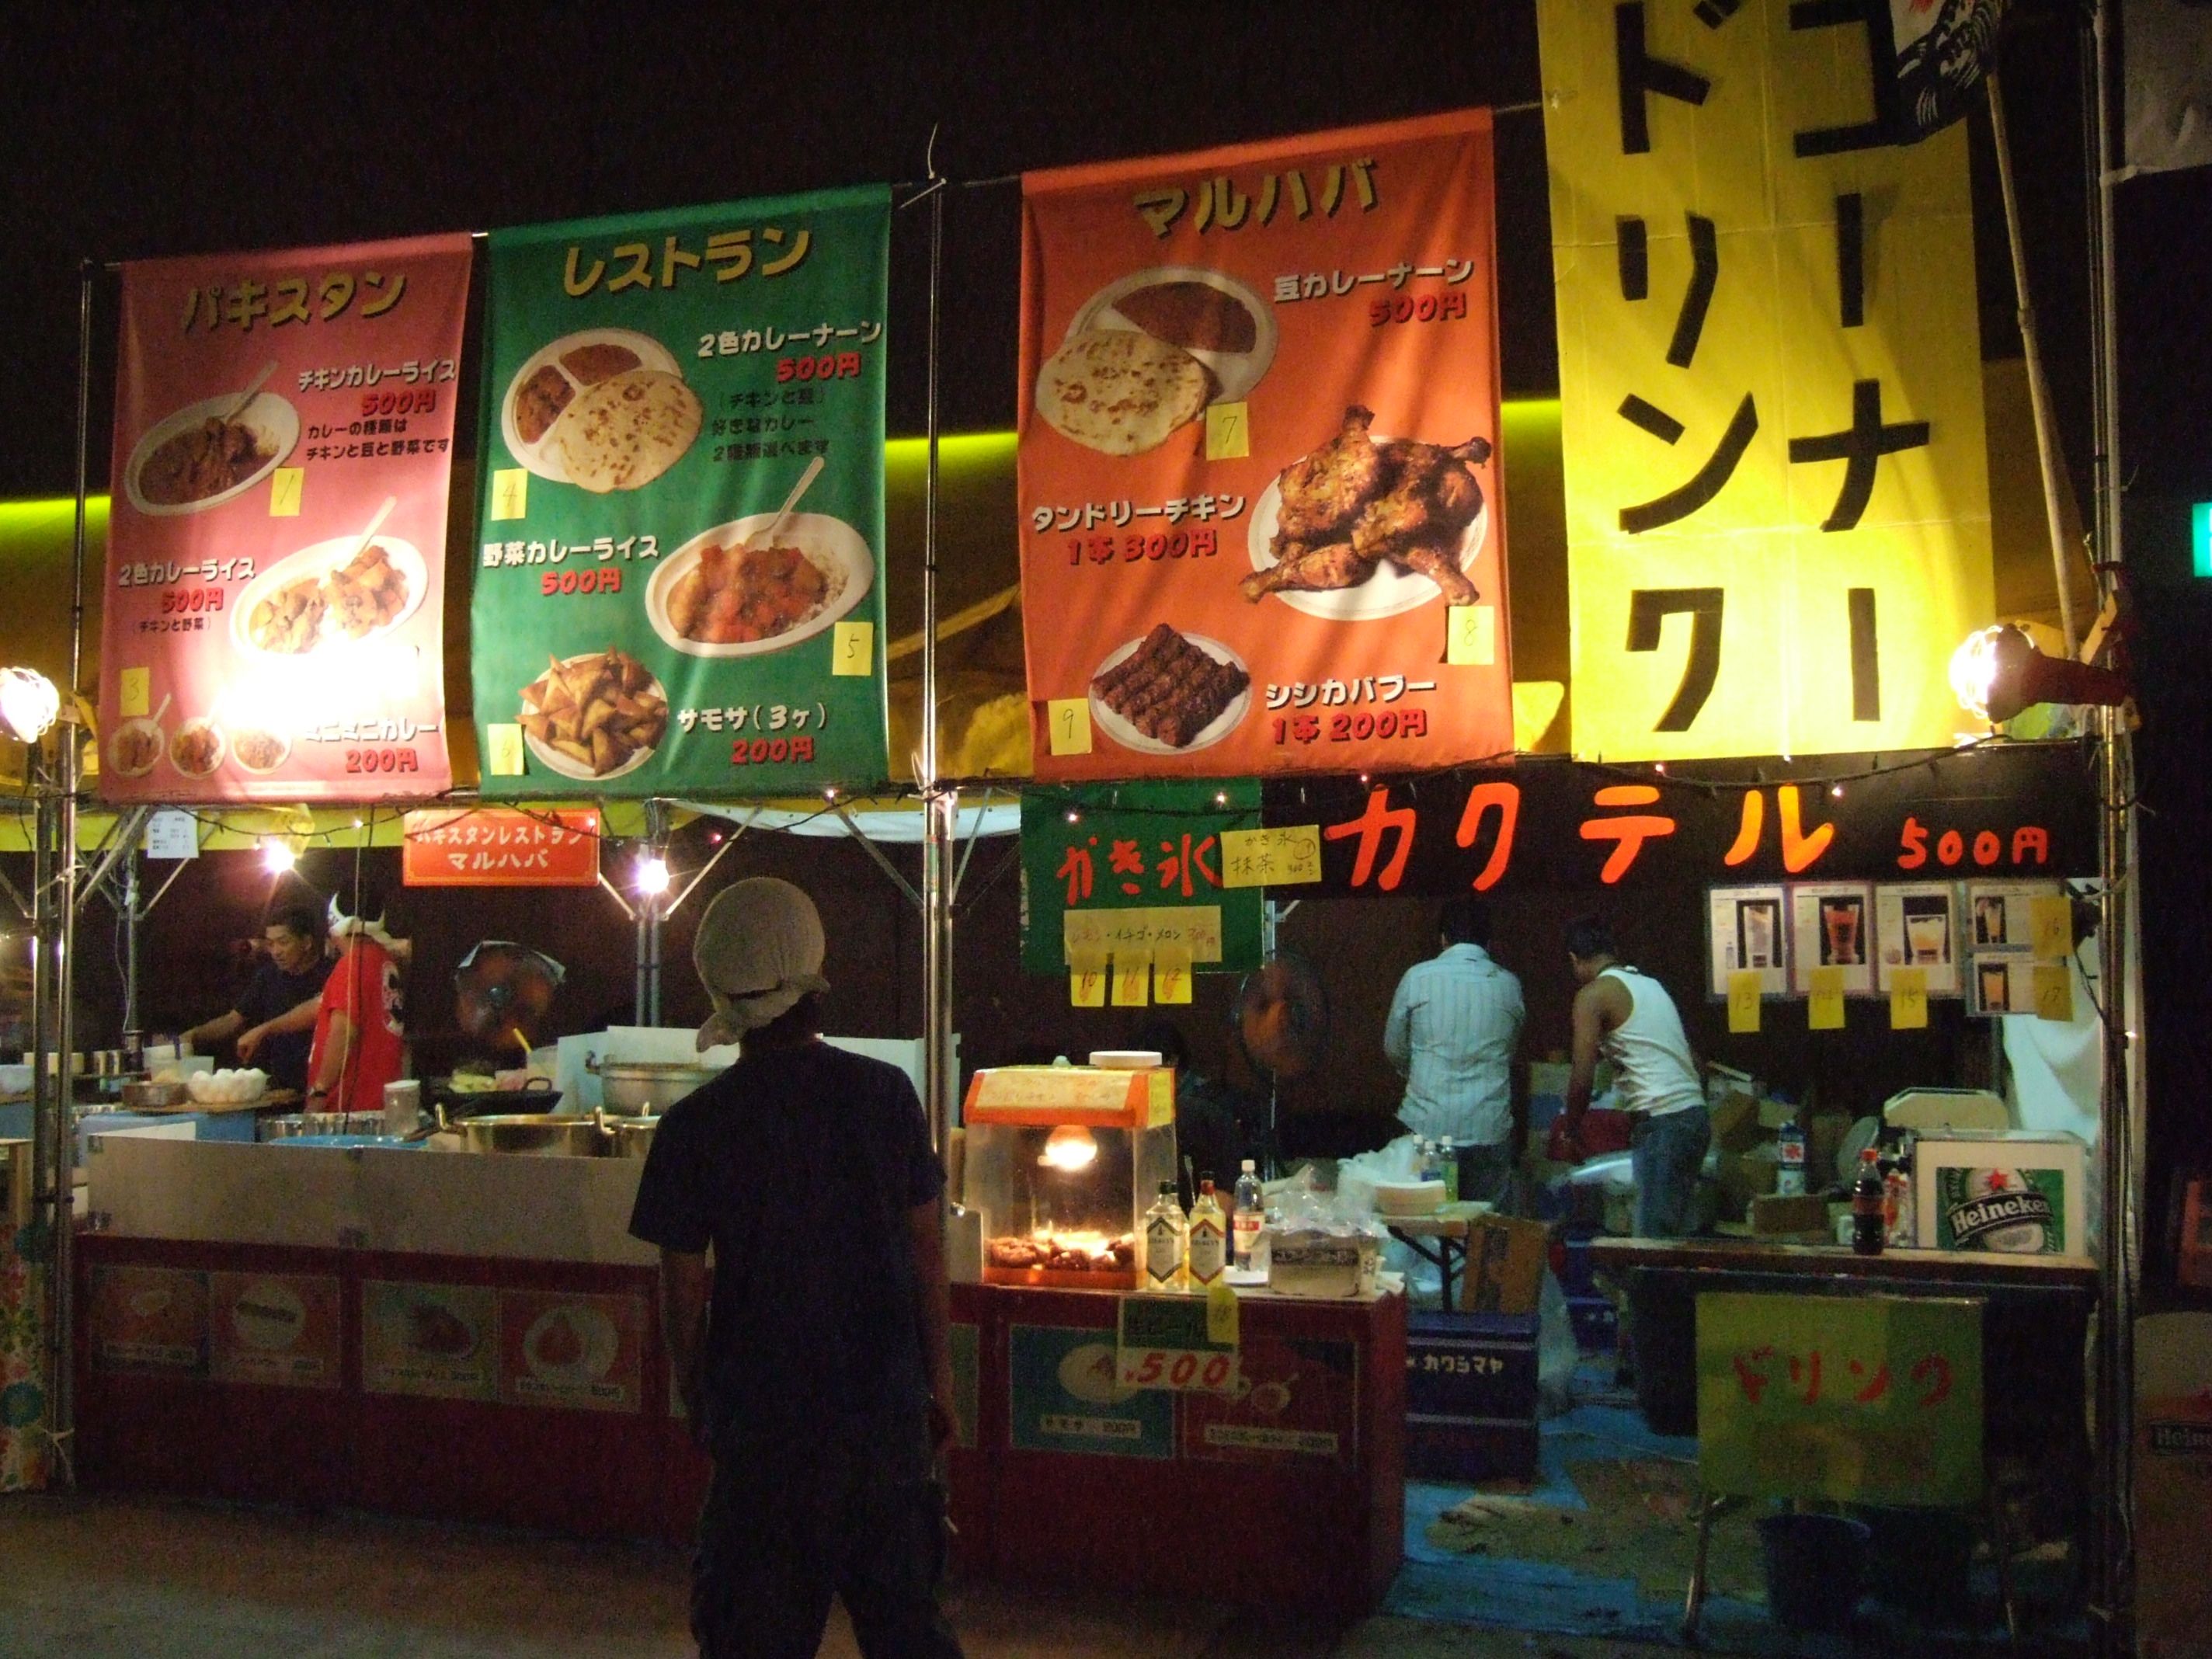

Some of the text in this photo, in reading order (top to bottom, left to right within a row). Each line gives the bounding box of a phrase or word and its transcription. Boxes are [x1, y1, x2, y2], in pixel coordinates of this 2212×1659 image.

[1133, 155, 1378, 238] マルハバ
[562, 228, 812, 297] レストラン
[1273, 258, 1476, 304] 豆カレーナーン
[183, 273, 407, 333] パキスタン
[1370, 293, 1467, 327] 500円
[697, 320, 883, 358] 2色カレーナーン
[298, 358, 457, 392] チキンカレーライス
[776, 352, 862, 383] 500円
[361, 390, 436, 417] 500円
[308, 419, 408, 440] カレーの種類は
[1222, 415, 1238, 444] 7
[306, 438, 450, 461] チキンと豆と野菜です
[1031, 493, 1247, 532] タンドリーチキン
[482, 534, 660, 569] 野菜カレーライス
[1123, 529, 1218, 562] 300円
[119, 556, 256, 588] 2色カレーライス
[540, 569, 621, 596] 500円
[162, 587, 224, 614] 500円
[847, 634, 860, 659] 5
[1463, 617, 1479, 648] 8
[1062, 708, 1076, 739] 9
[1329, 709, 1429, 742] 200円
[345, 747, 419, 773] 200円
[730, 736, 816, 765] 200円
[1325, 782, 1834, 892] カクテル
[1897, 816, 2048, 869] 500円
[447, 848, 548, 870] マルハバ
